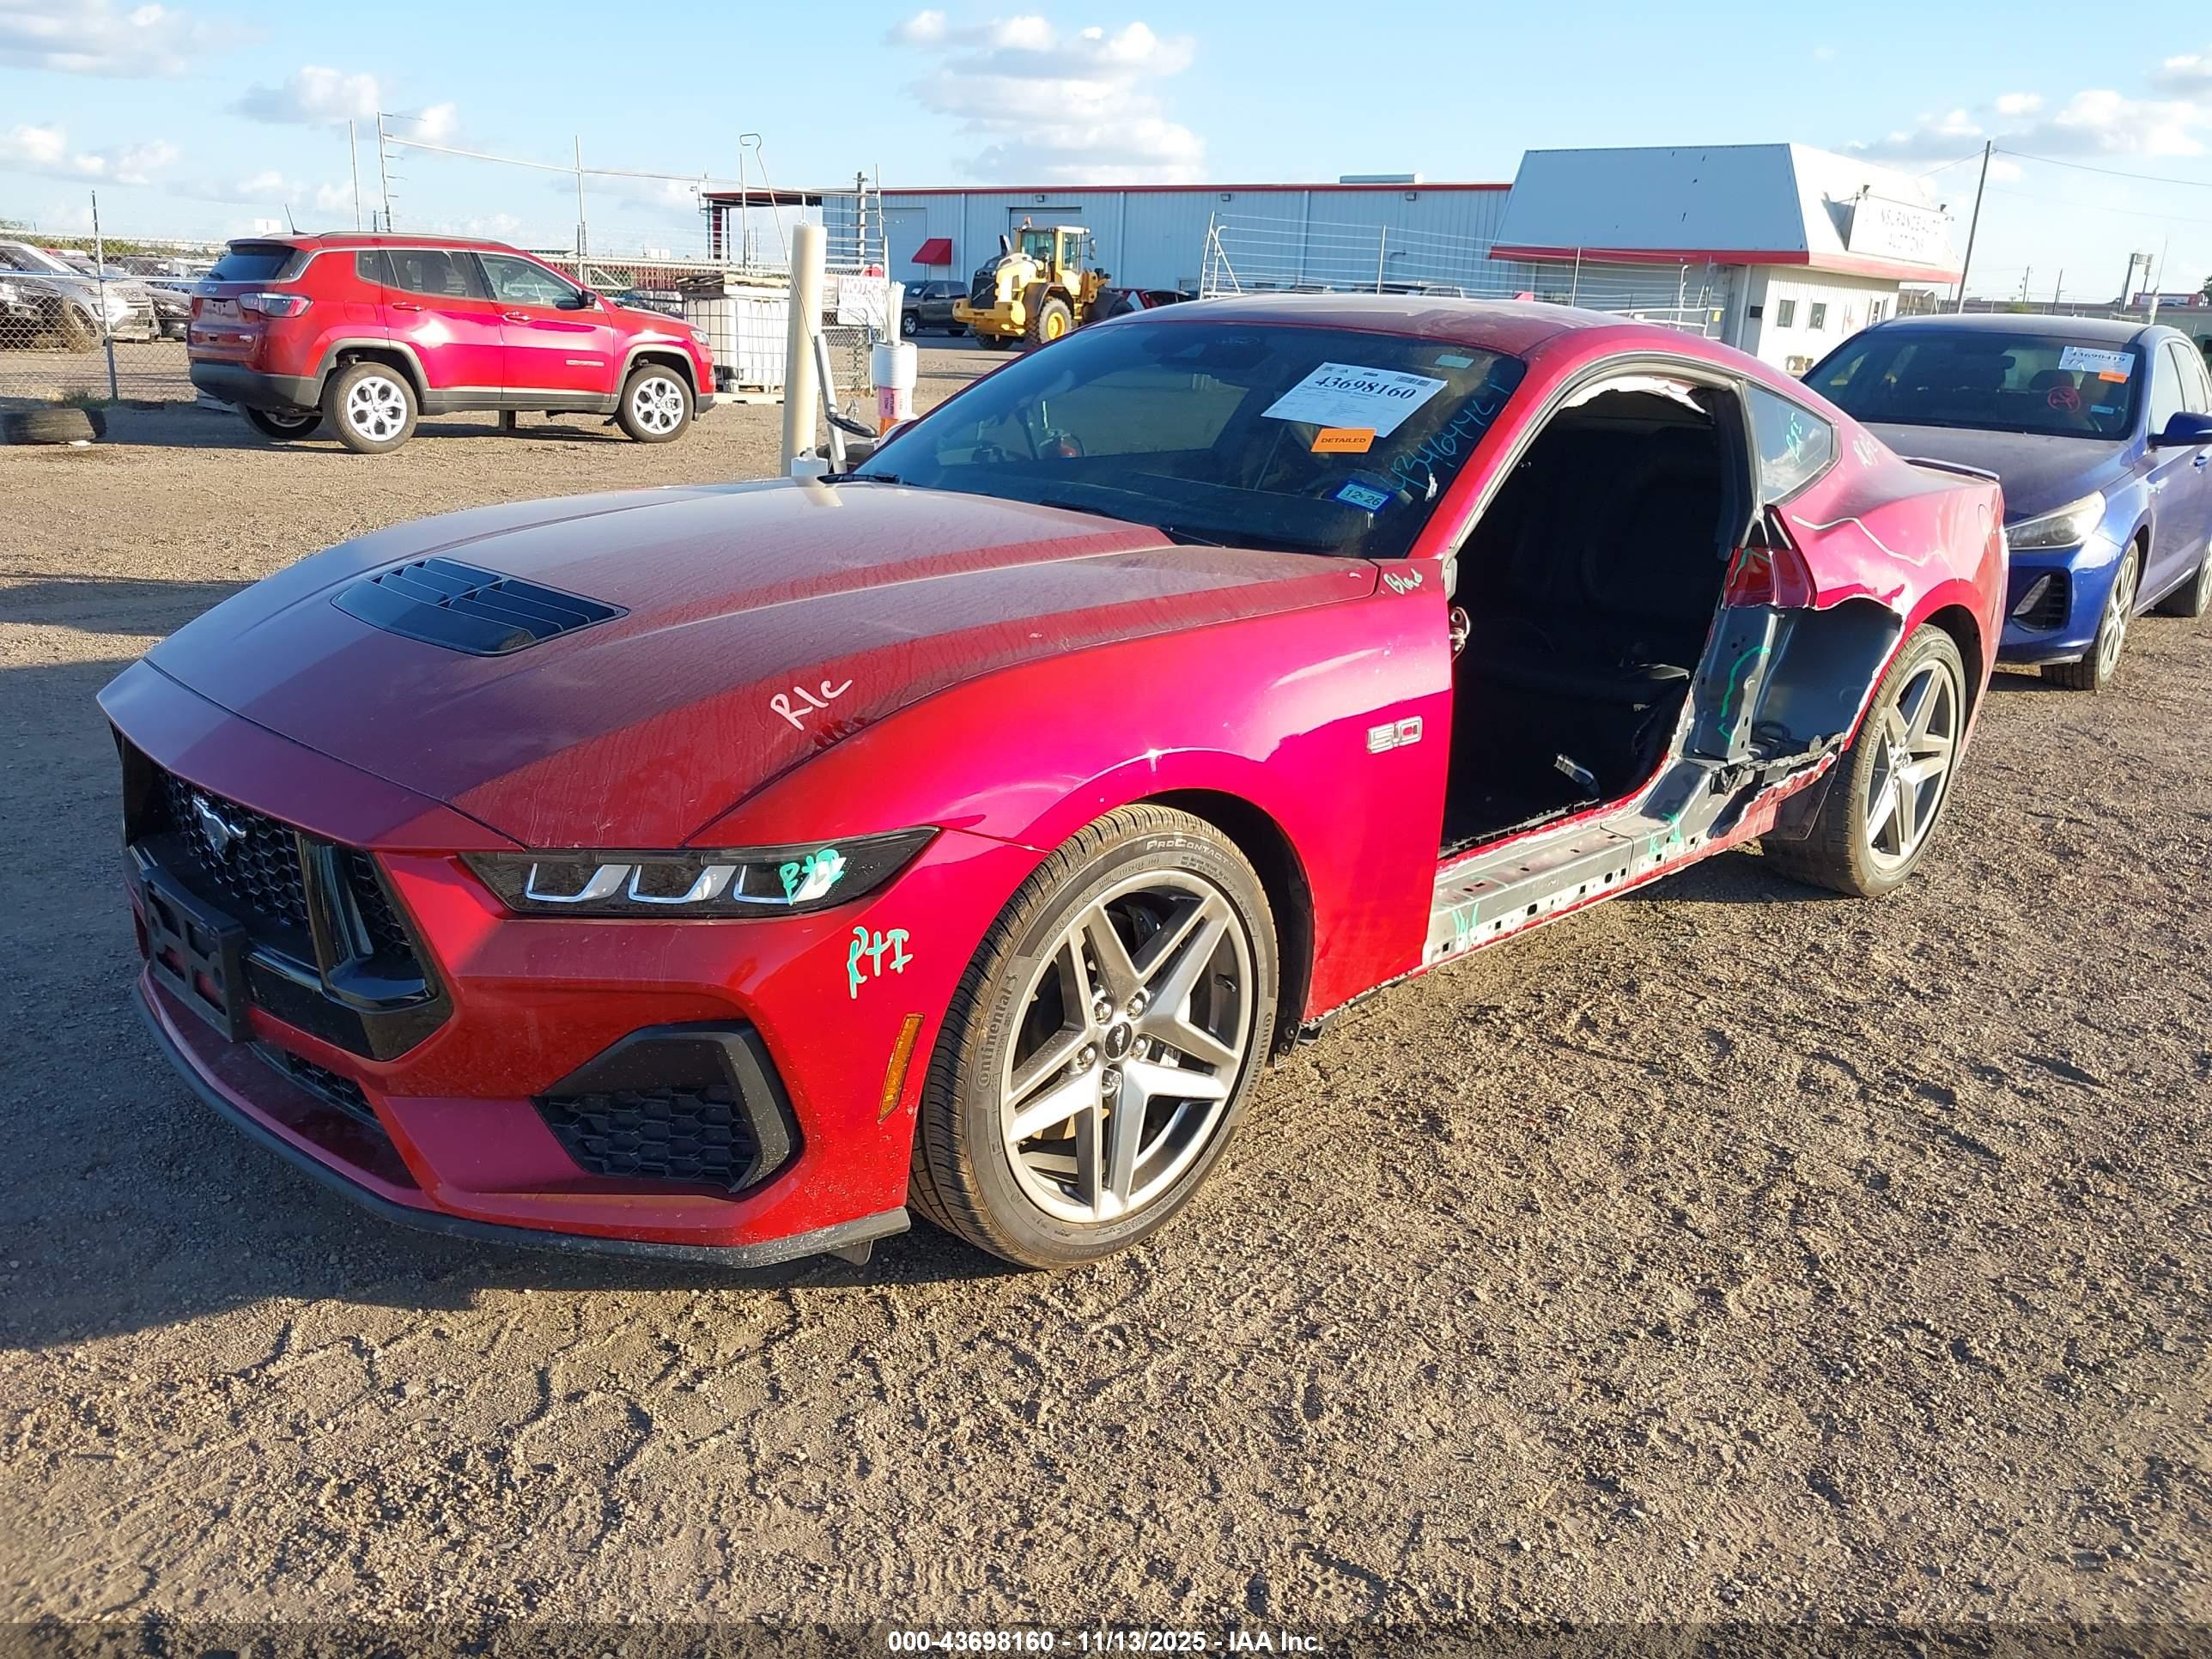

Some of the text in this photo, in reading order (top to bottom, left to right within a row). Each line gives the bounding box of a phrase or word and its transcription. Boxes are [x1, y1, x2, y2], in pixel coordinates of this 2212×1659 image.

[1315, 375, 1417, 399] 43698160
[1367, 714, 1424, 754] 5.0
[975, 994, 1012, 1087] Continental
[1245, 1012, 1273, 1099] Continental
